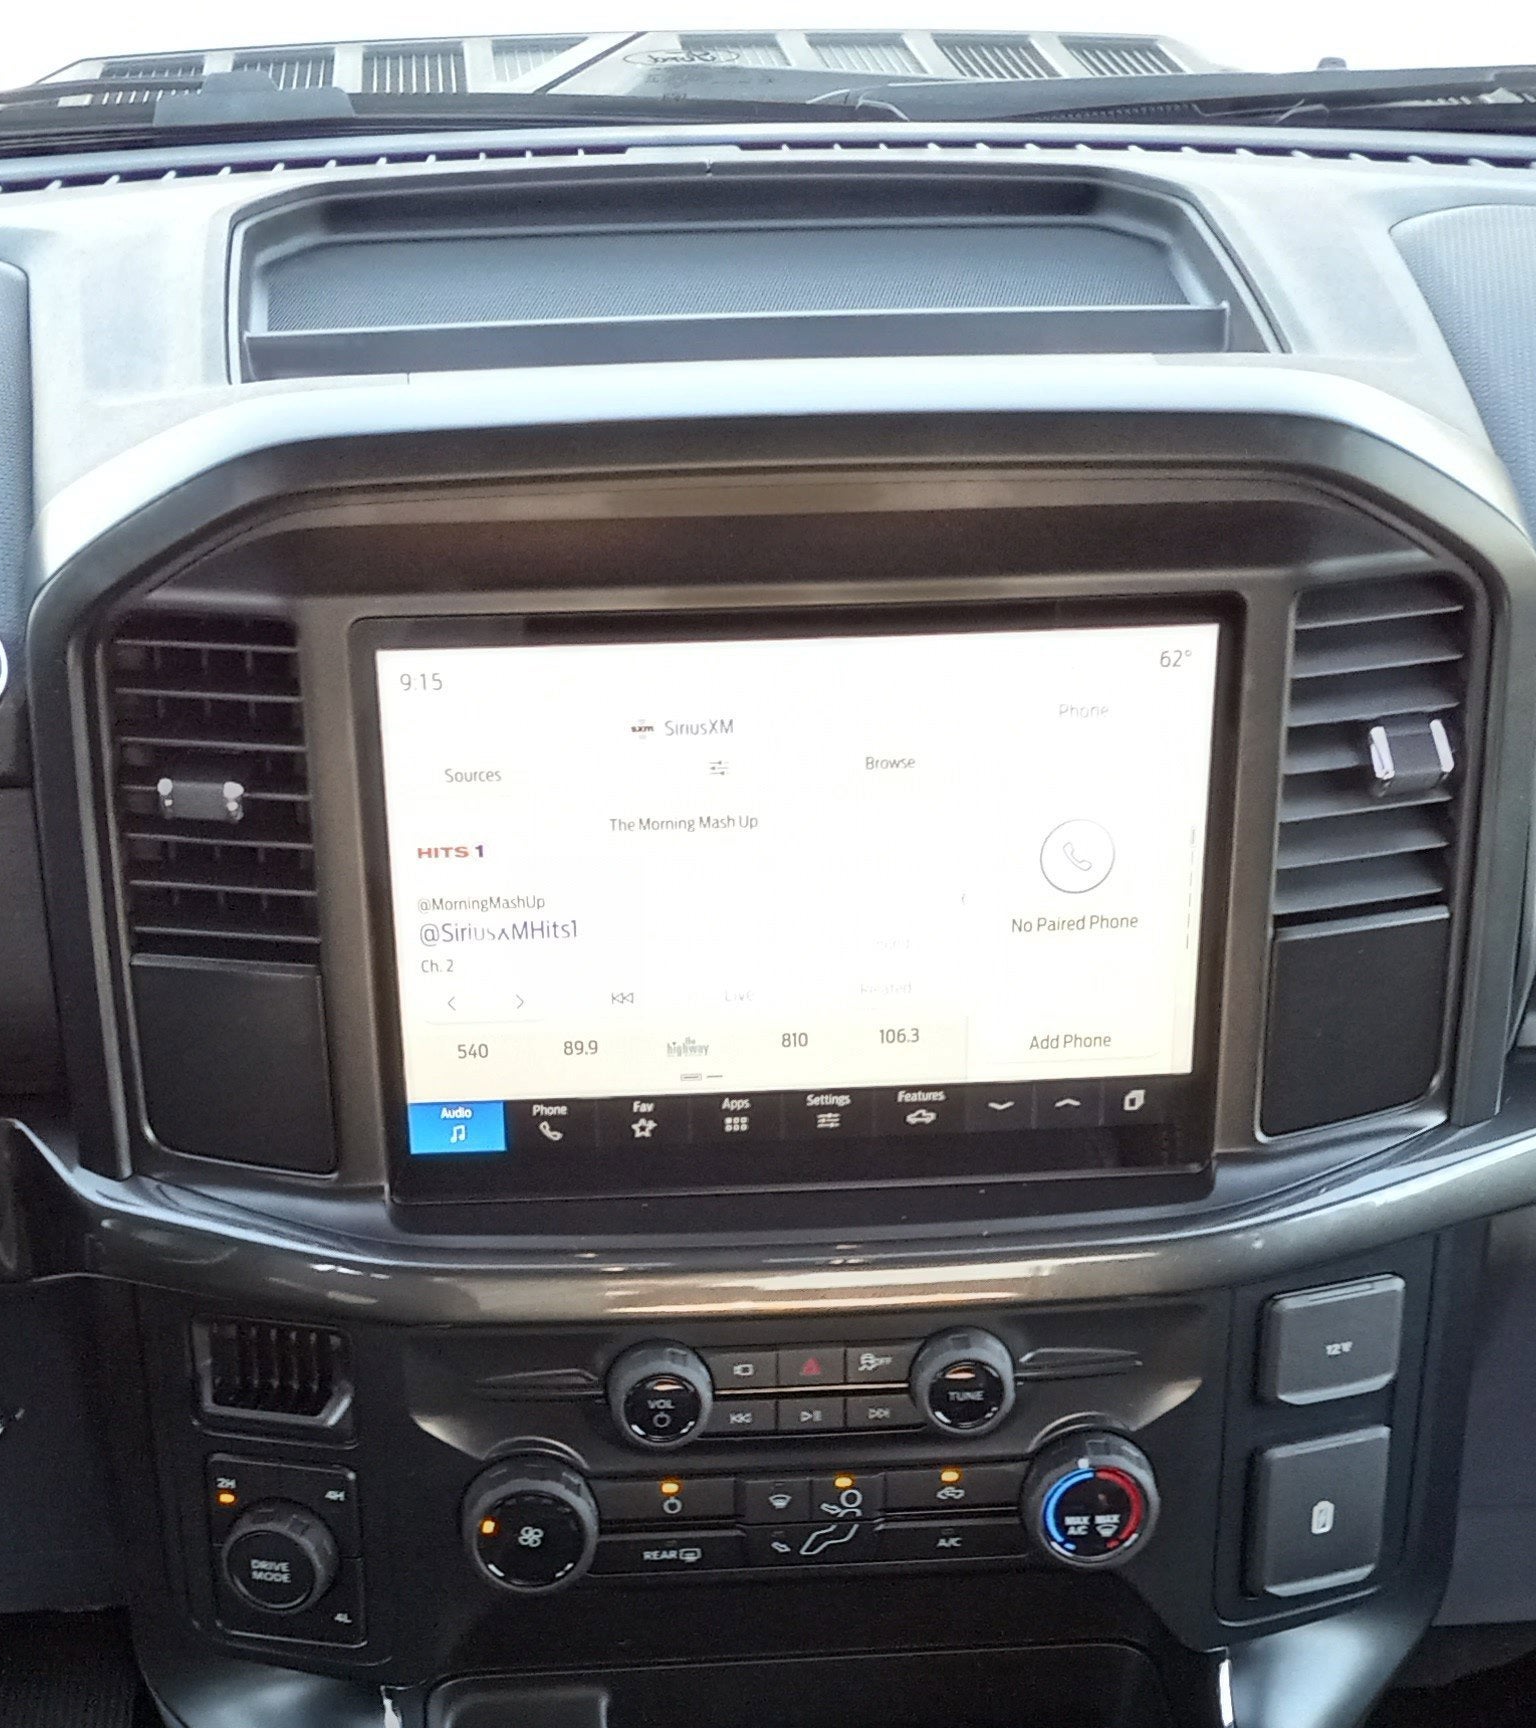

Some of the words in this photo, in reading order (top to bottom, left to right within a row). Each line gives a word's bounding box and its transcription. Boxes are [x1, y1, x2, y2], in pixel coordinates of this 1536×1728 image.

[400, 673, 443, 691] 9:15
[664, 718, 735, 736] SiriusXM
[865, 756, 916, 770] Browse
[444, 768, 502, 783] Sources
[609, 818, 635, 832] The
[638, 817, 695, 832] Morning
[699, 816, 735, 829] Mash
[738, 815, 759, 831] Up
[417, 846, 469, 858] HITS
[475, 845, 485, 858] 1
[417, 895, 546, 913] @MorningMashUp
[1011, 918, 1033, 933] No
[1037, 916, 1086, 932] Paired
[1089, 914, 1139, 930] Phone
[421, 960, 443, 973] Ch.
[446, 960, 454, 973] 2
[781, 1032, 809, 1048] 810
[879, 1028, 920, 1043] 106.3
[1029, 1035, 1059, 1050] Add
[1063, 1033, 1112, 1048] Phone
[457, 1043, 489, 1059] 540
[563, 1040, 599, 1056] 89.9
[667, 1042, 710, 1057] highway
[806, 1093, 851, 1107] Settings
[897, 1090, 946, 1103] Features
[532, 1103, 568, 1116] Phone
[633, 1100, 654, 1112] Fav
[722, 1097, 751, 1111] Apps
[440, 1107, 472, 1119] Audio
[948, 1390, 985, 1401] TUNE
[647, 1399, 675, 1409] VOL
[217, 1478, 236, 1489] 2H
[325, 1490, 345, 1501] 4H
[1064, 1515, 1090, 1525] MAX
[1094, 1514, 1120, 1524] MAX
[1067, 1525, 1088, 1536] A/C
[937, 1537, 963, 1547] A/C
[643, 1549, 679, 1560] REAR
[250, 1558, 290, 1573] DRIVE
[251, 1570, 292, 1583] MODE
[334, 1612, 352, 1624] 4L
